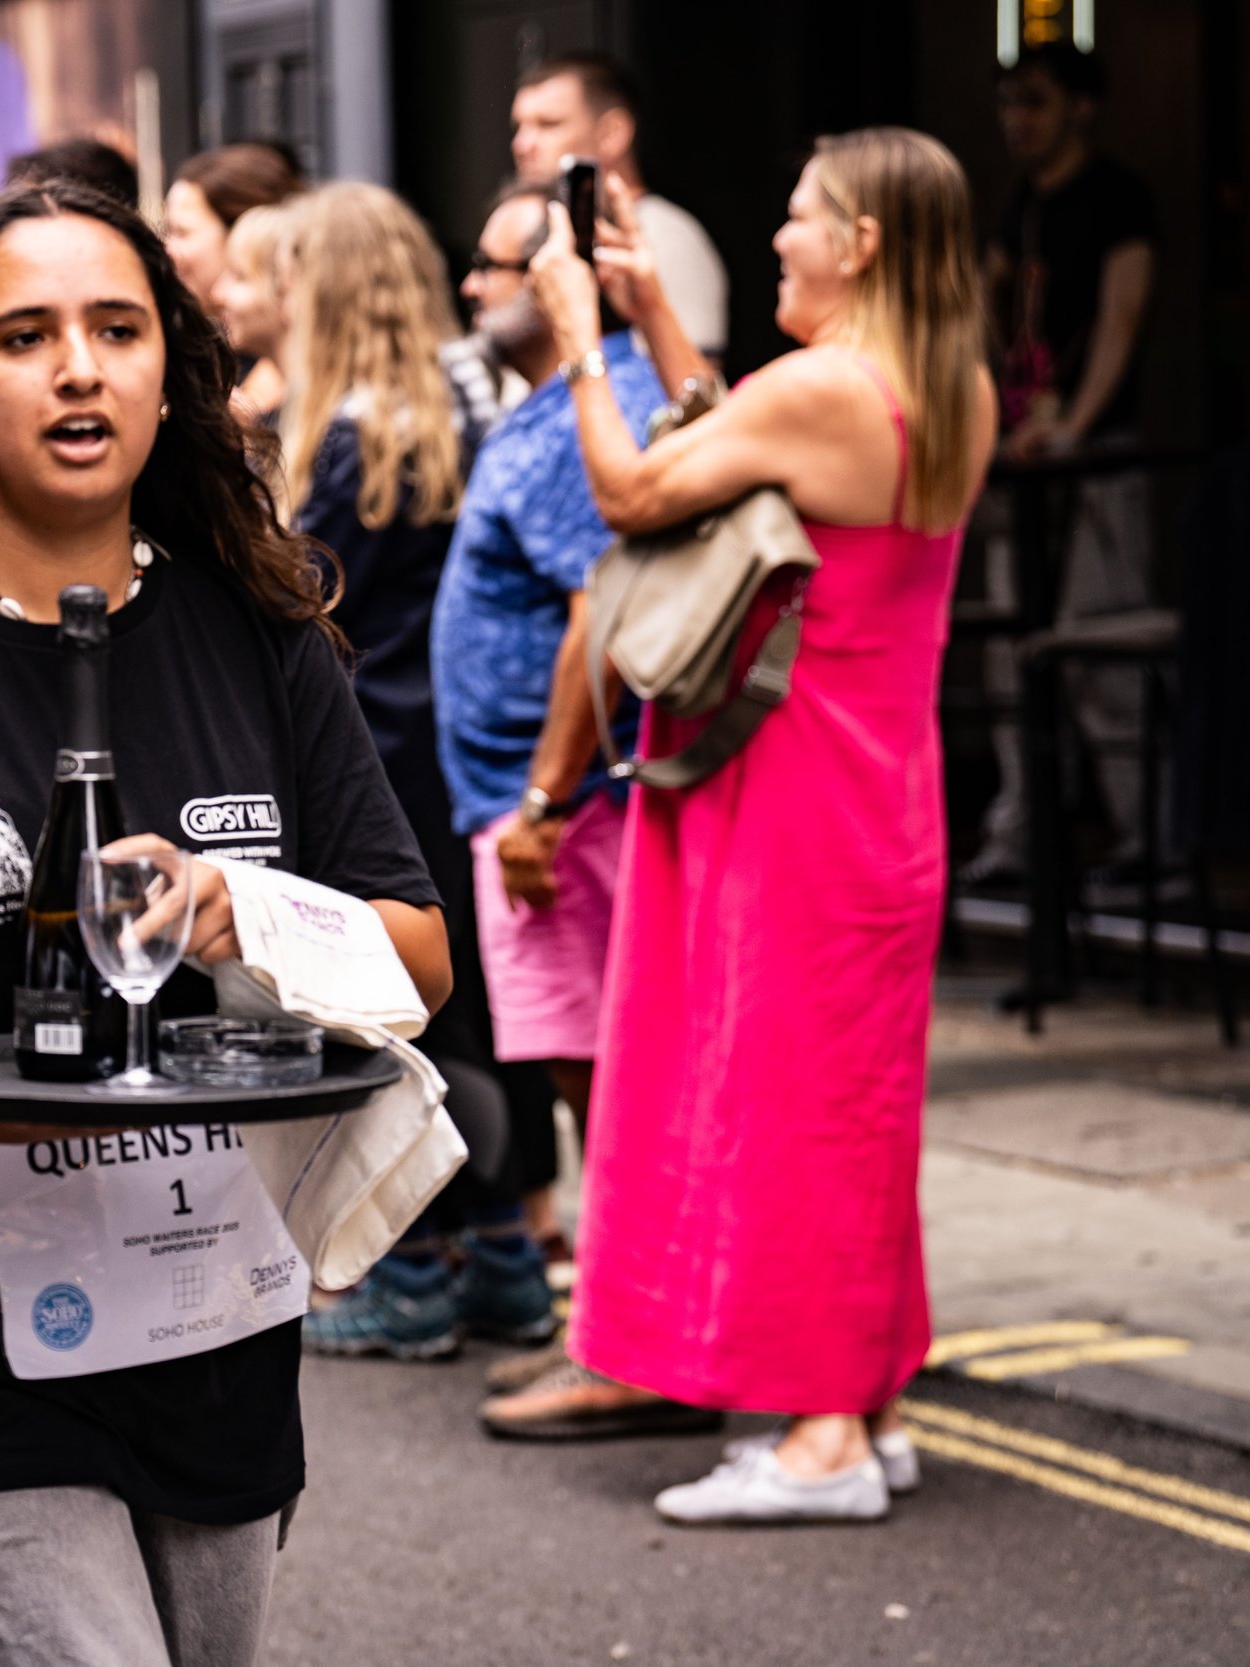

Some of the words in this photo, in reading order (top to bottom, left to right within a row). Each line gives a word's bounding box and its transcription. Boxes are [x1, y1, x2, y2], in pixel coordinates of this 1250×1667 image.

[189, 803, 246, 833] GIPSY
[27, 1123, 192, 1178] QUEENS
[170, 1178, 193, 1216] 1
[123, 1234, 151, 1248] SOHO
[152, 1228, 195, 1244] WAITERS
[196, 1224, 220, 1237] RACE
[150, 1240, 204, 1257] SUPPORTED
[206, 1238, 218, 1249] BY
[250, 1255, 296, 1286] DENNYS
[148, 1322, 184, 1343] SOHO
[186, 1313, 225, 1334] HOUSE
